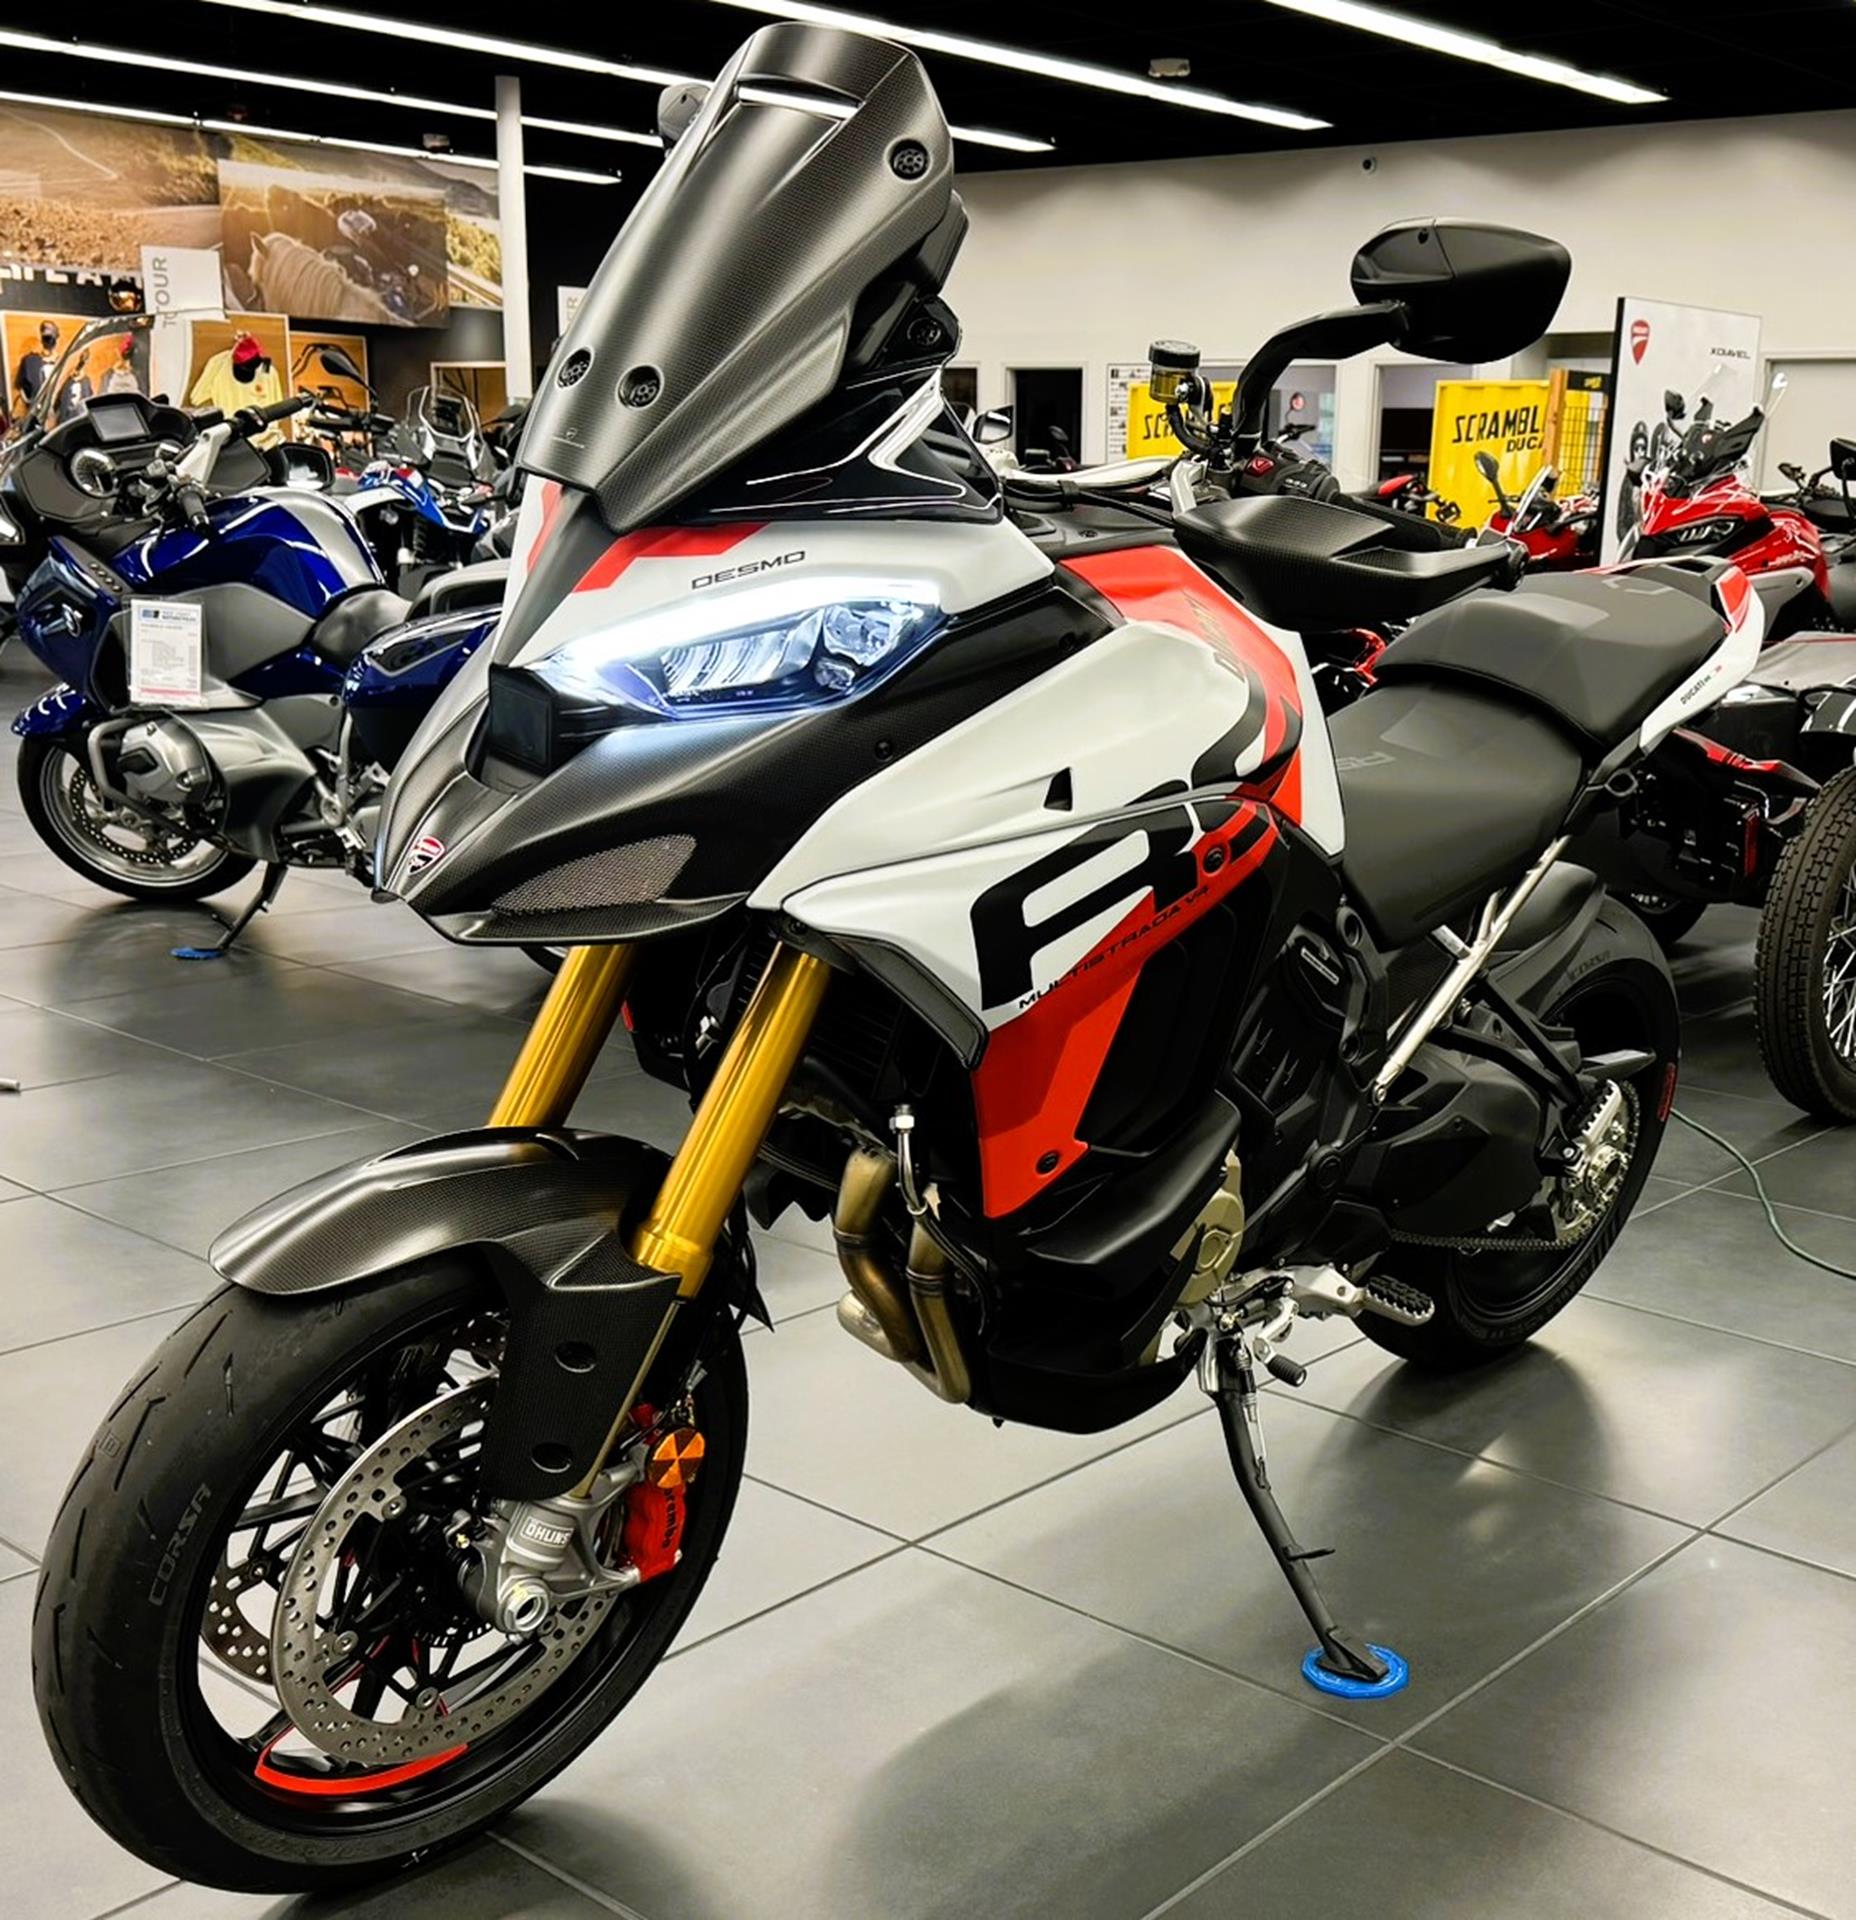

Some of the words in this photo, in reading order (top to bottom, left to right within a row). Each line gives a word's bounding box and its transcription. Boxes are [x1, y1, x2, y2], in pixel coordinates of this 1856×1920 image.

[1452, 405, 1545, 444] SCRAMBL
[691, 550, 806, 590] DESMO
[1018, 906, 1182, 1009] MULTISTRADA
[1184, 885, 1210, 905] V4
[148, 1483, 212, 1607] CORSA
